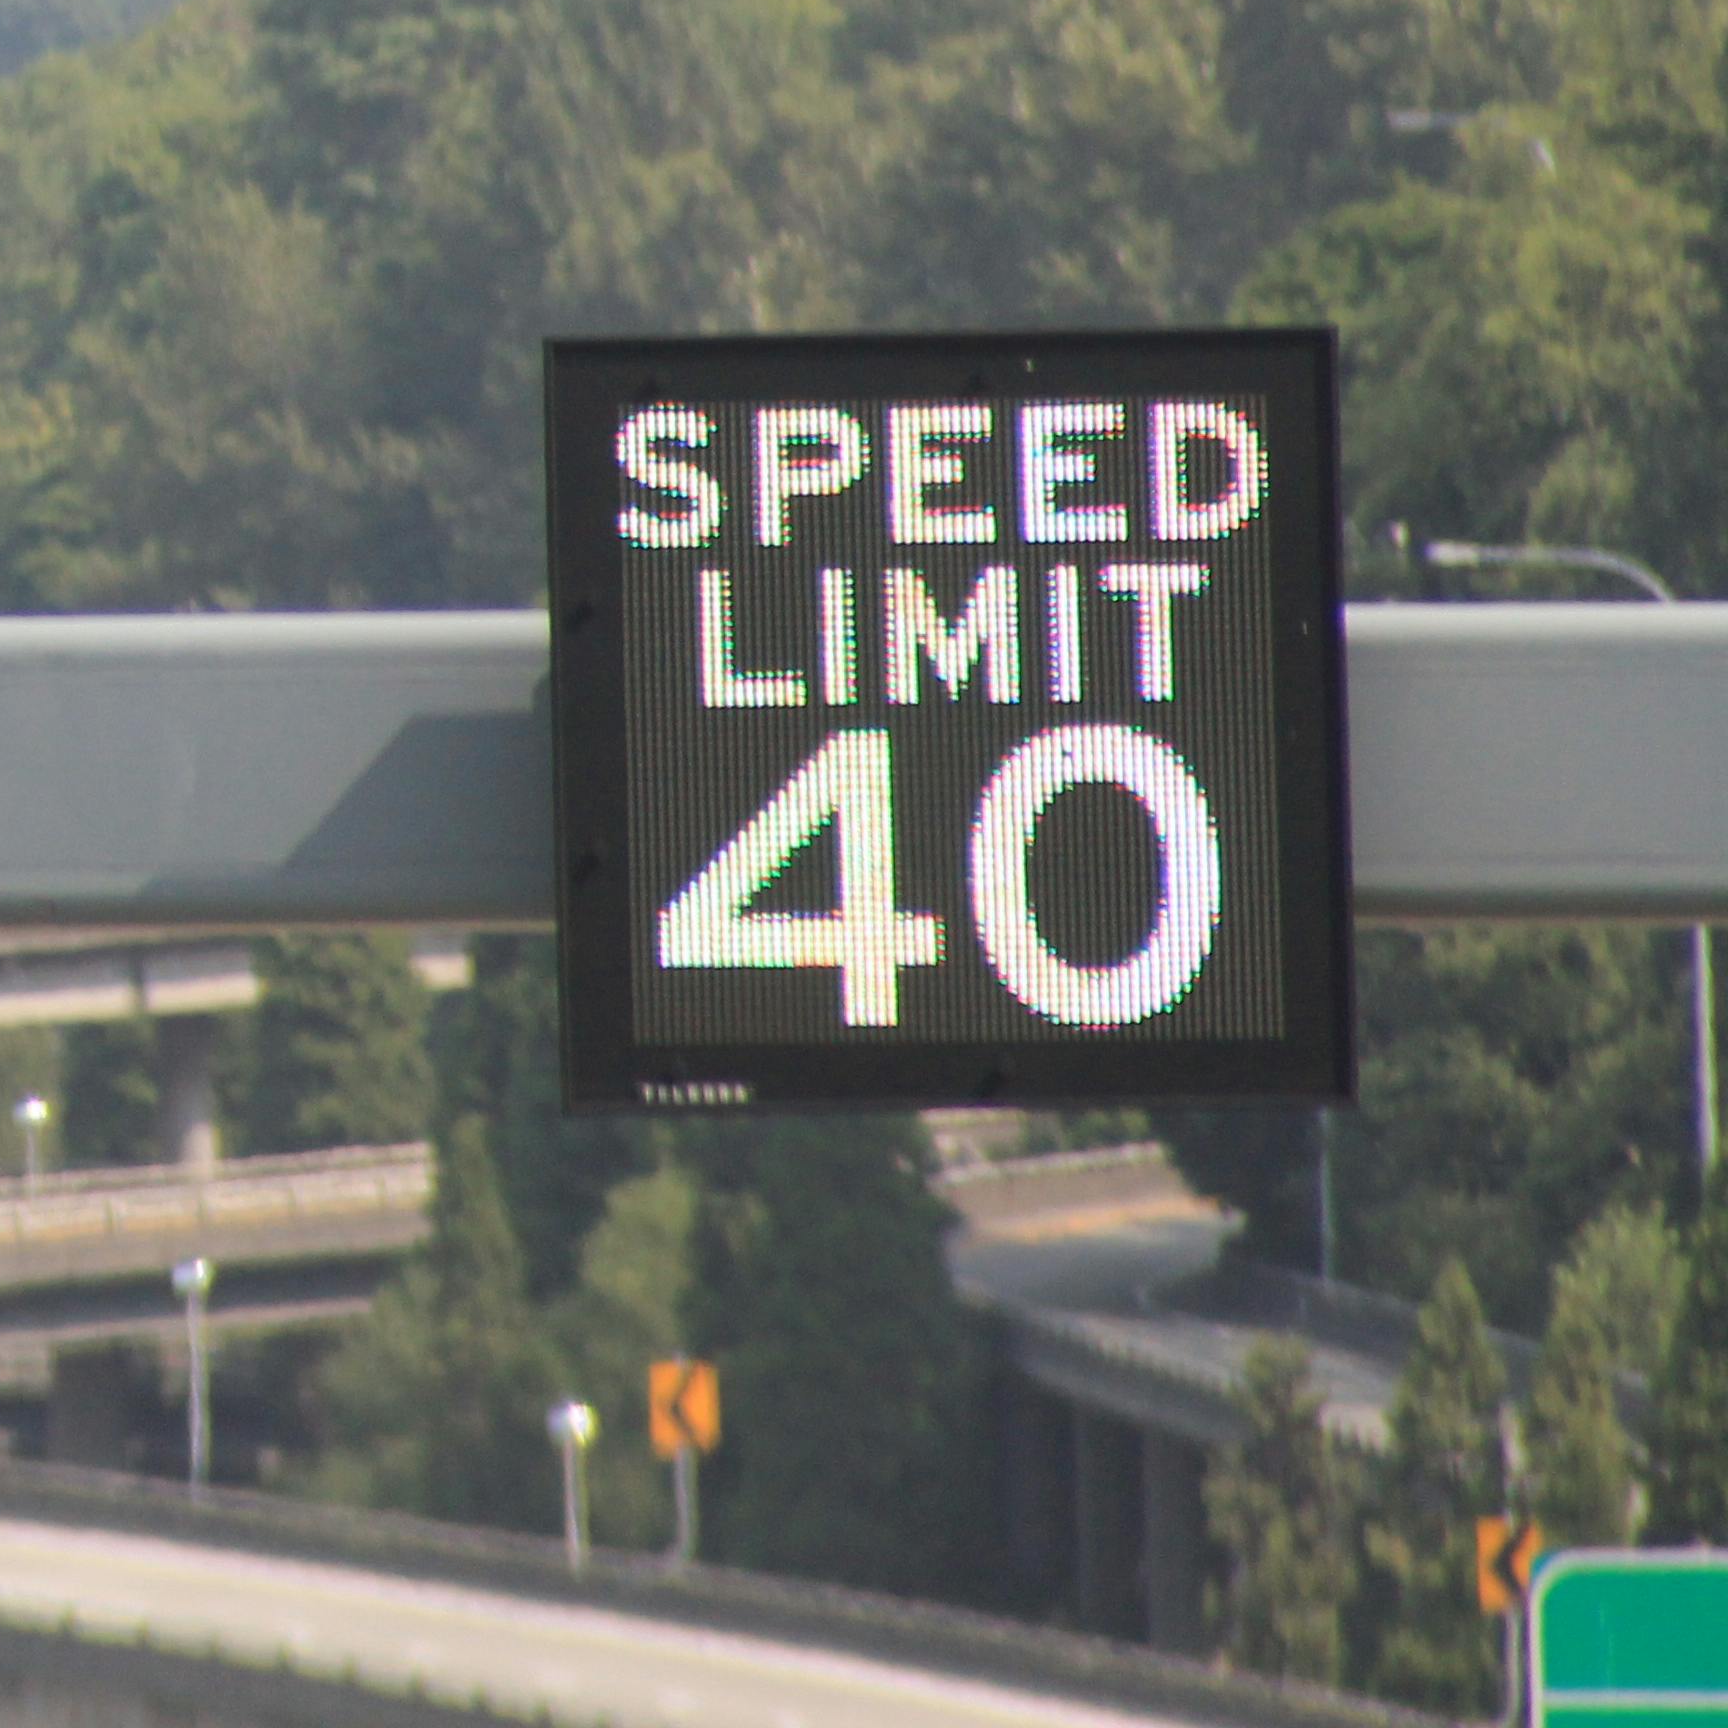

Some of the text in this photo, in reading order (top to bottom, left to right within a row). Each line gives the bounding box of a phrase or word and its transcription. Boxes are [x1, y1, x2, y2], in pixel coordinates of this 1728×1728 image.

[616, 402, 1269, 549] SPEED
[699, 563, 1210, 708] LIMIT
[658, 724, 1221, 1030] 40
